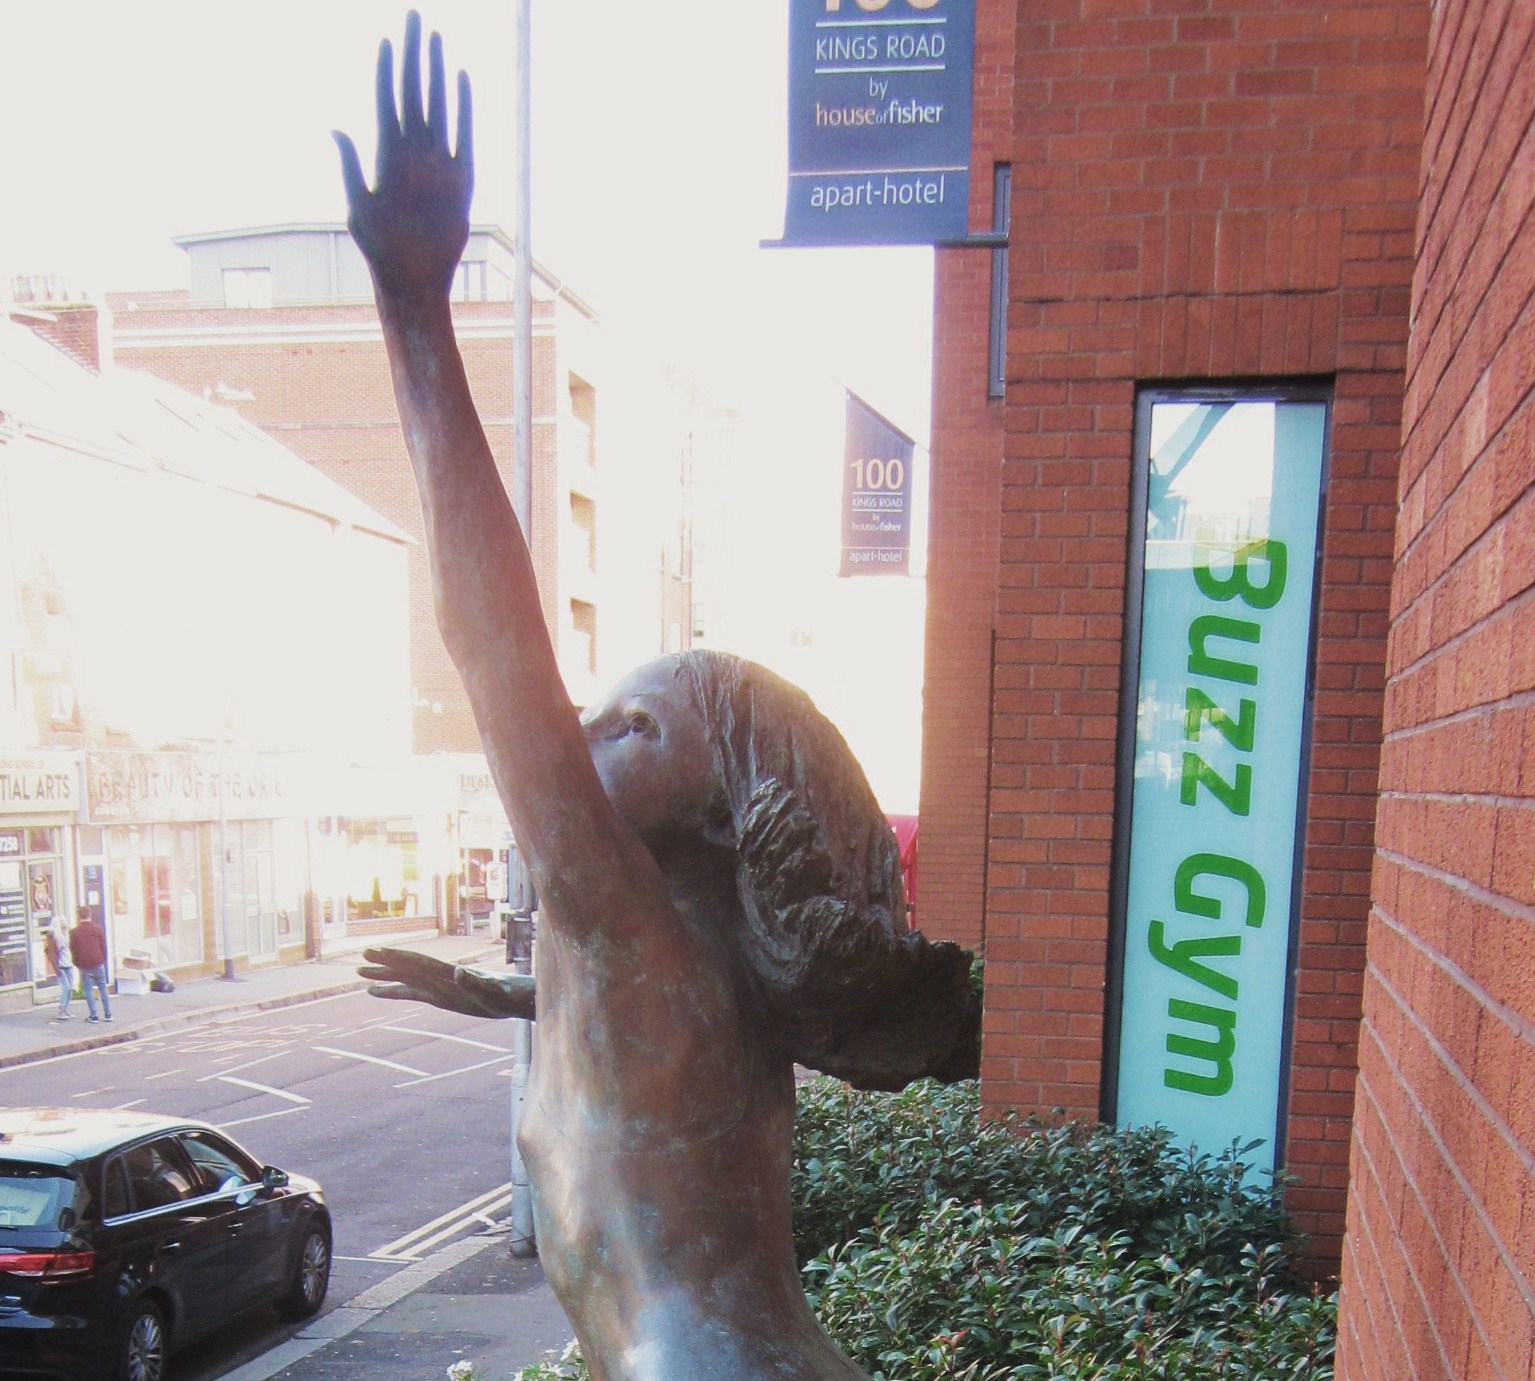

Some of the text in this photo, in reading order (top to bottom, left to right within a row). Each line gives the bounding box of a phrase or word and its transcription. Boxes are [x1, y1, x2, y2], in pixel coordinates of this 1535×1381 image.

[816, 35, 945, 61] KINGS ROAD
[869, 76, 888, 101] by
[811, 174, 944, 212] apart-hotel
[850, 459, 904, 490] 100
[852, 498, 902, 508] KINGS ROAD
[849, 550, 902, 562] apart-hotel
[36, 774, 71, 800] ARTS
[1148, 529, 1288, 1097] Buzz Gym
